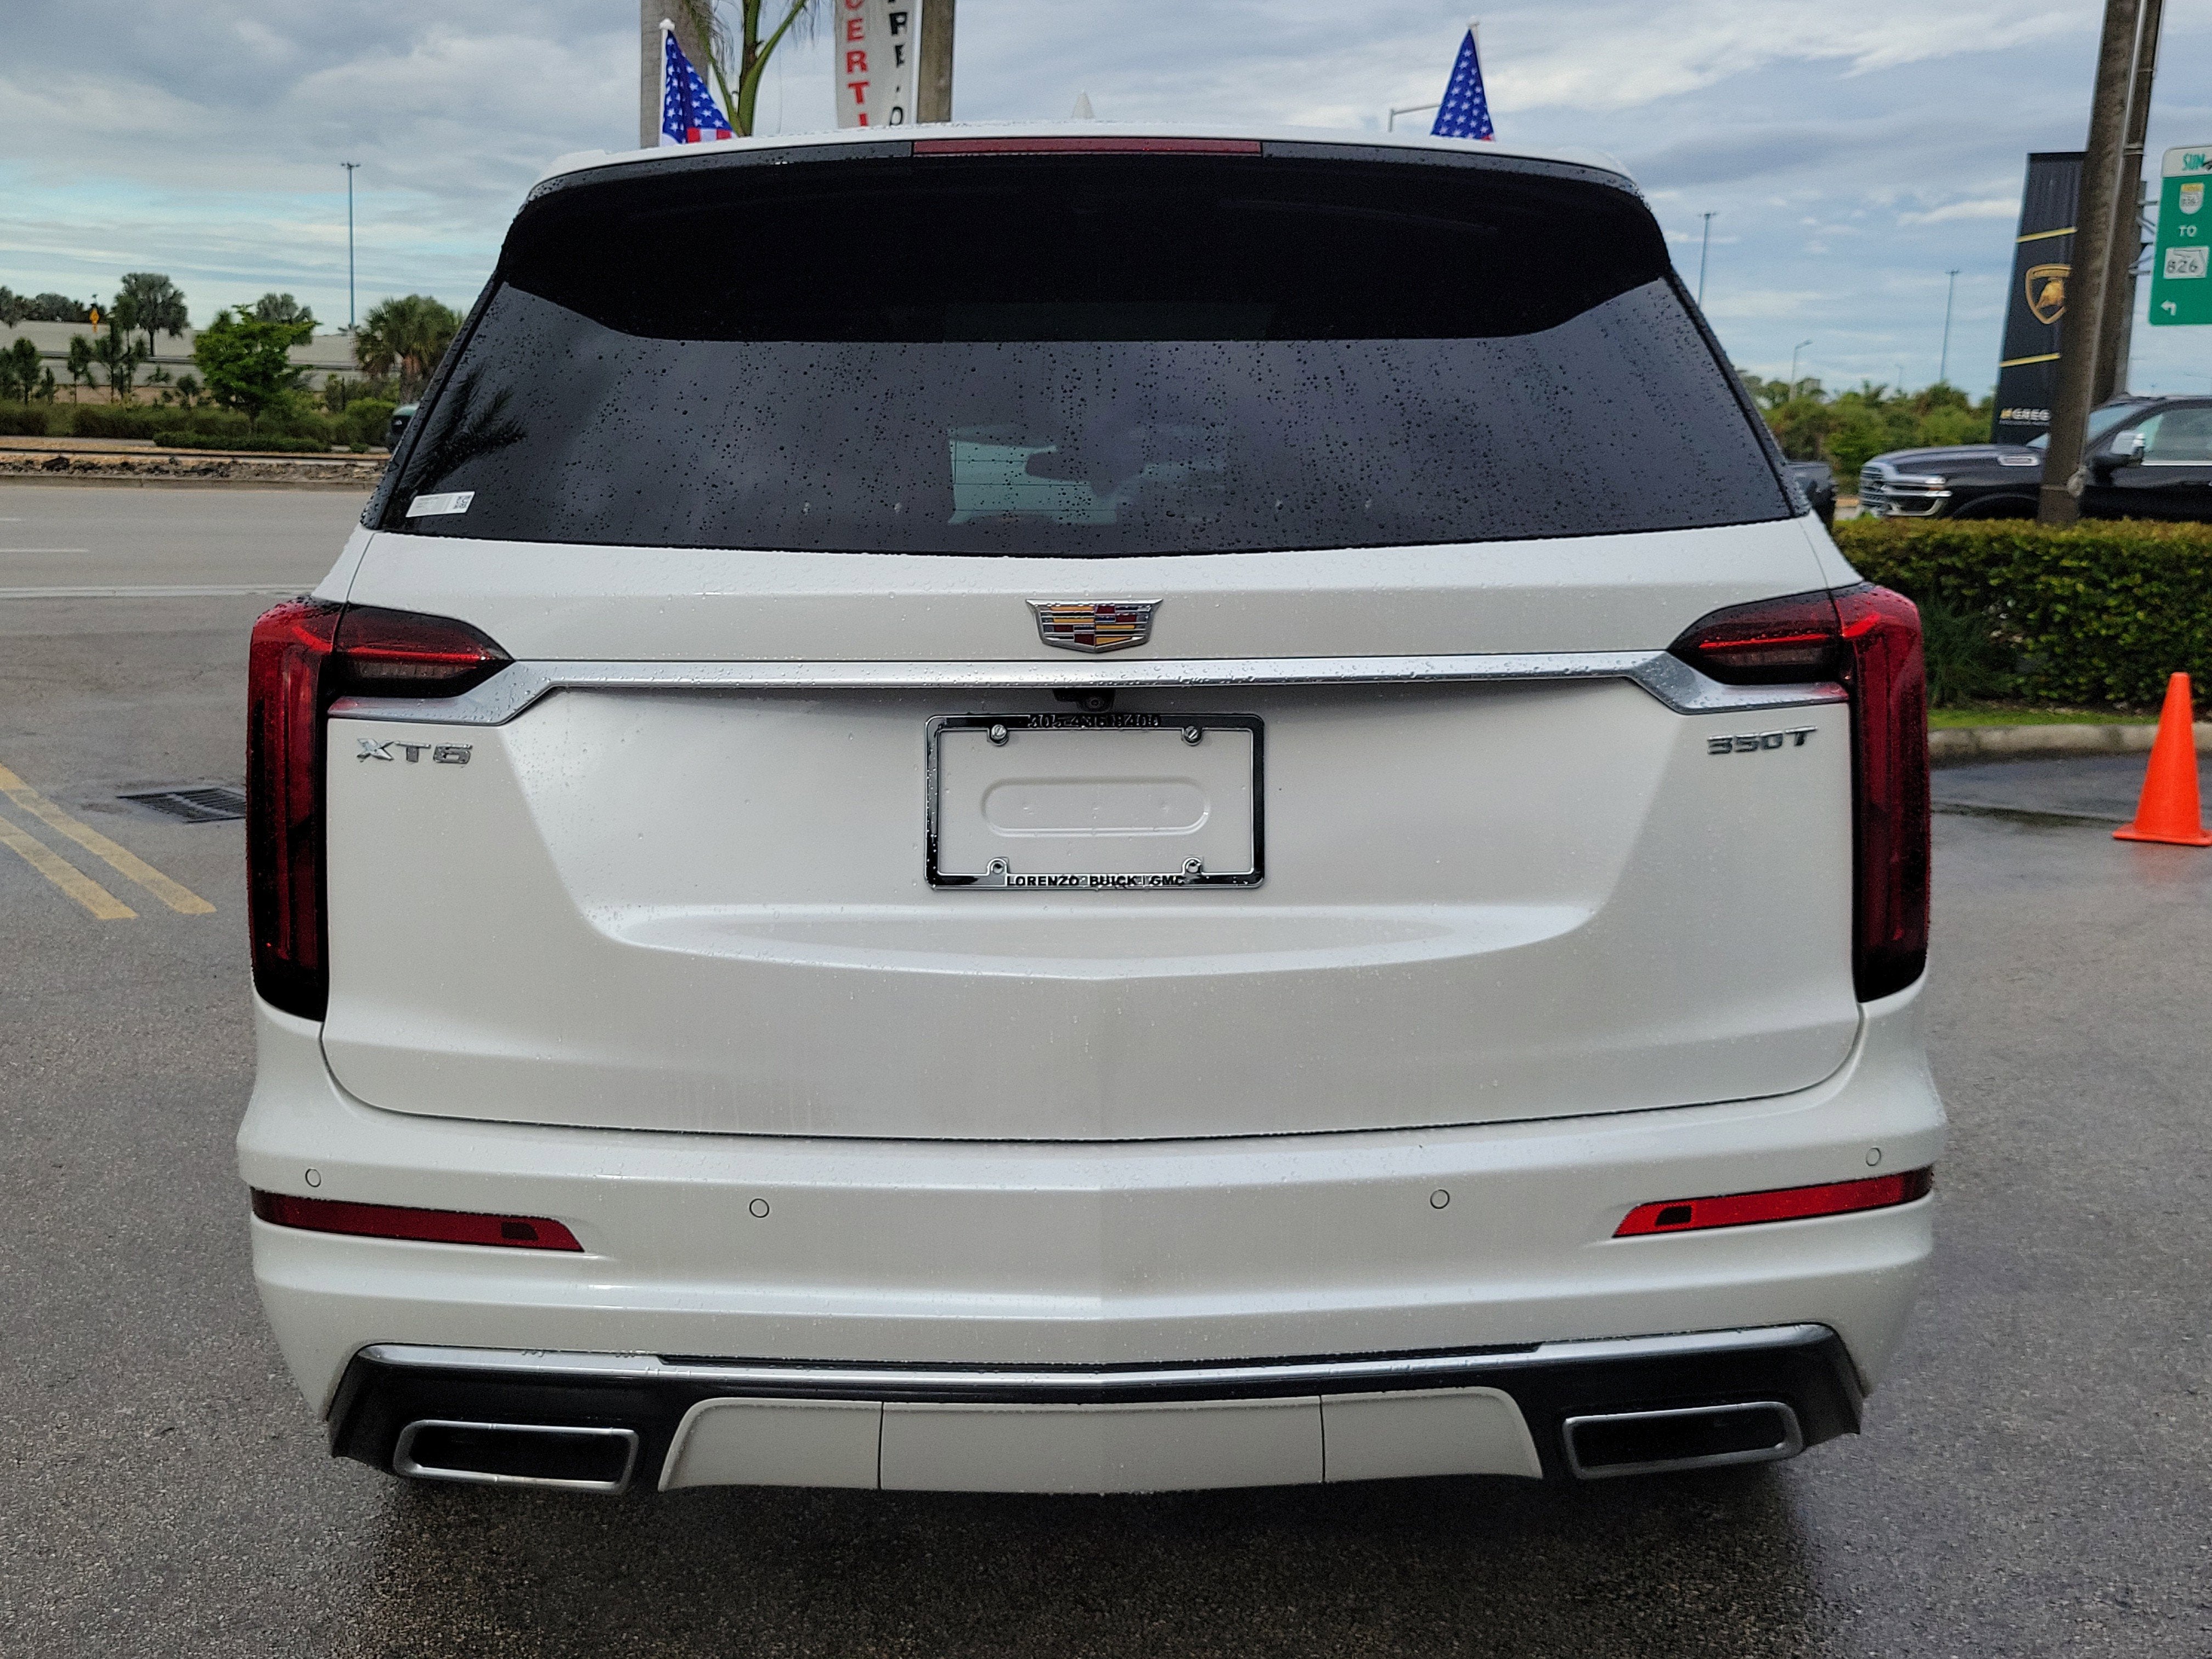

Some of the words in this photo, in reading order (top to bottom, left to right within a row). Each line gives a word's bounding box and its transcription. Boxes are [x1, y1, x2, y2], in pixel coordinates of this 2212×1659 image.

[2179, 225, 2197, 237] TO
[2166, 259, 2198, 273] 826
[1707, 725, 1818, 755] 350T
[357, 738, 473, 764] XT6
[1007, 876, 1079, 886] LORENZO
[1090, 875, 1137, 887] BUICK
[1148, 875, 1186, 886] GMC
